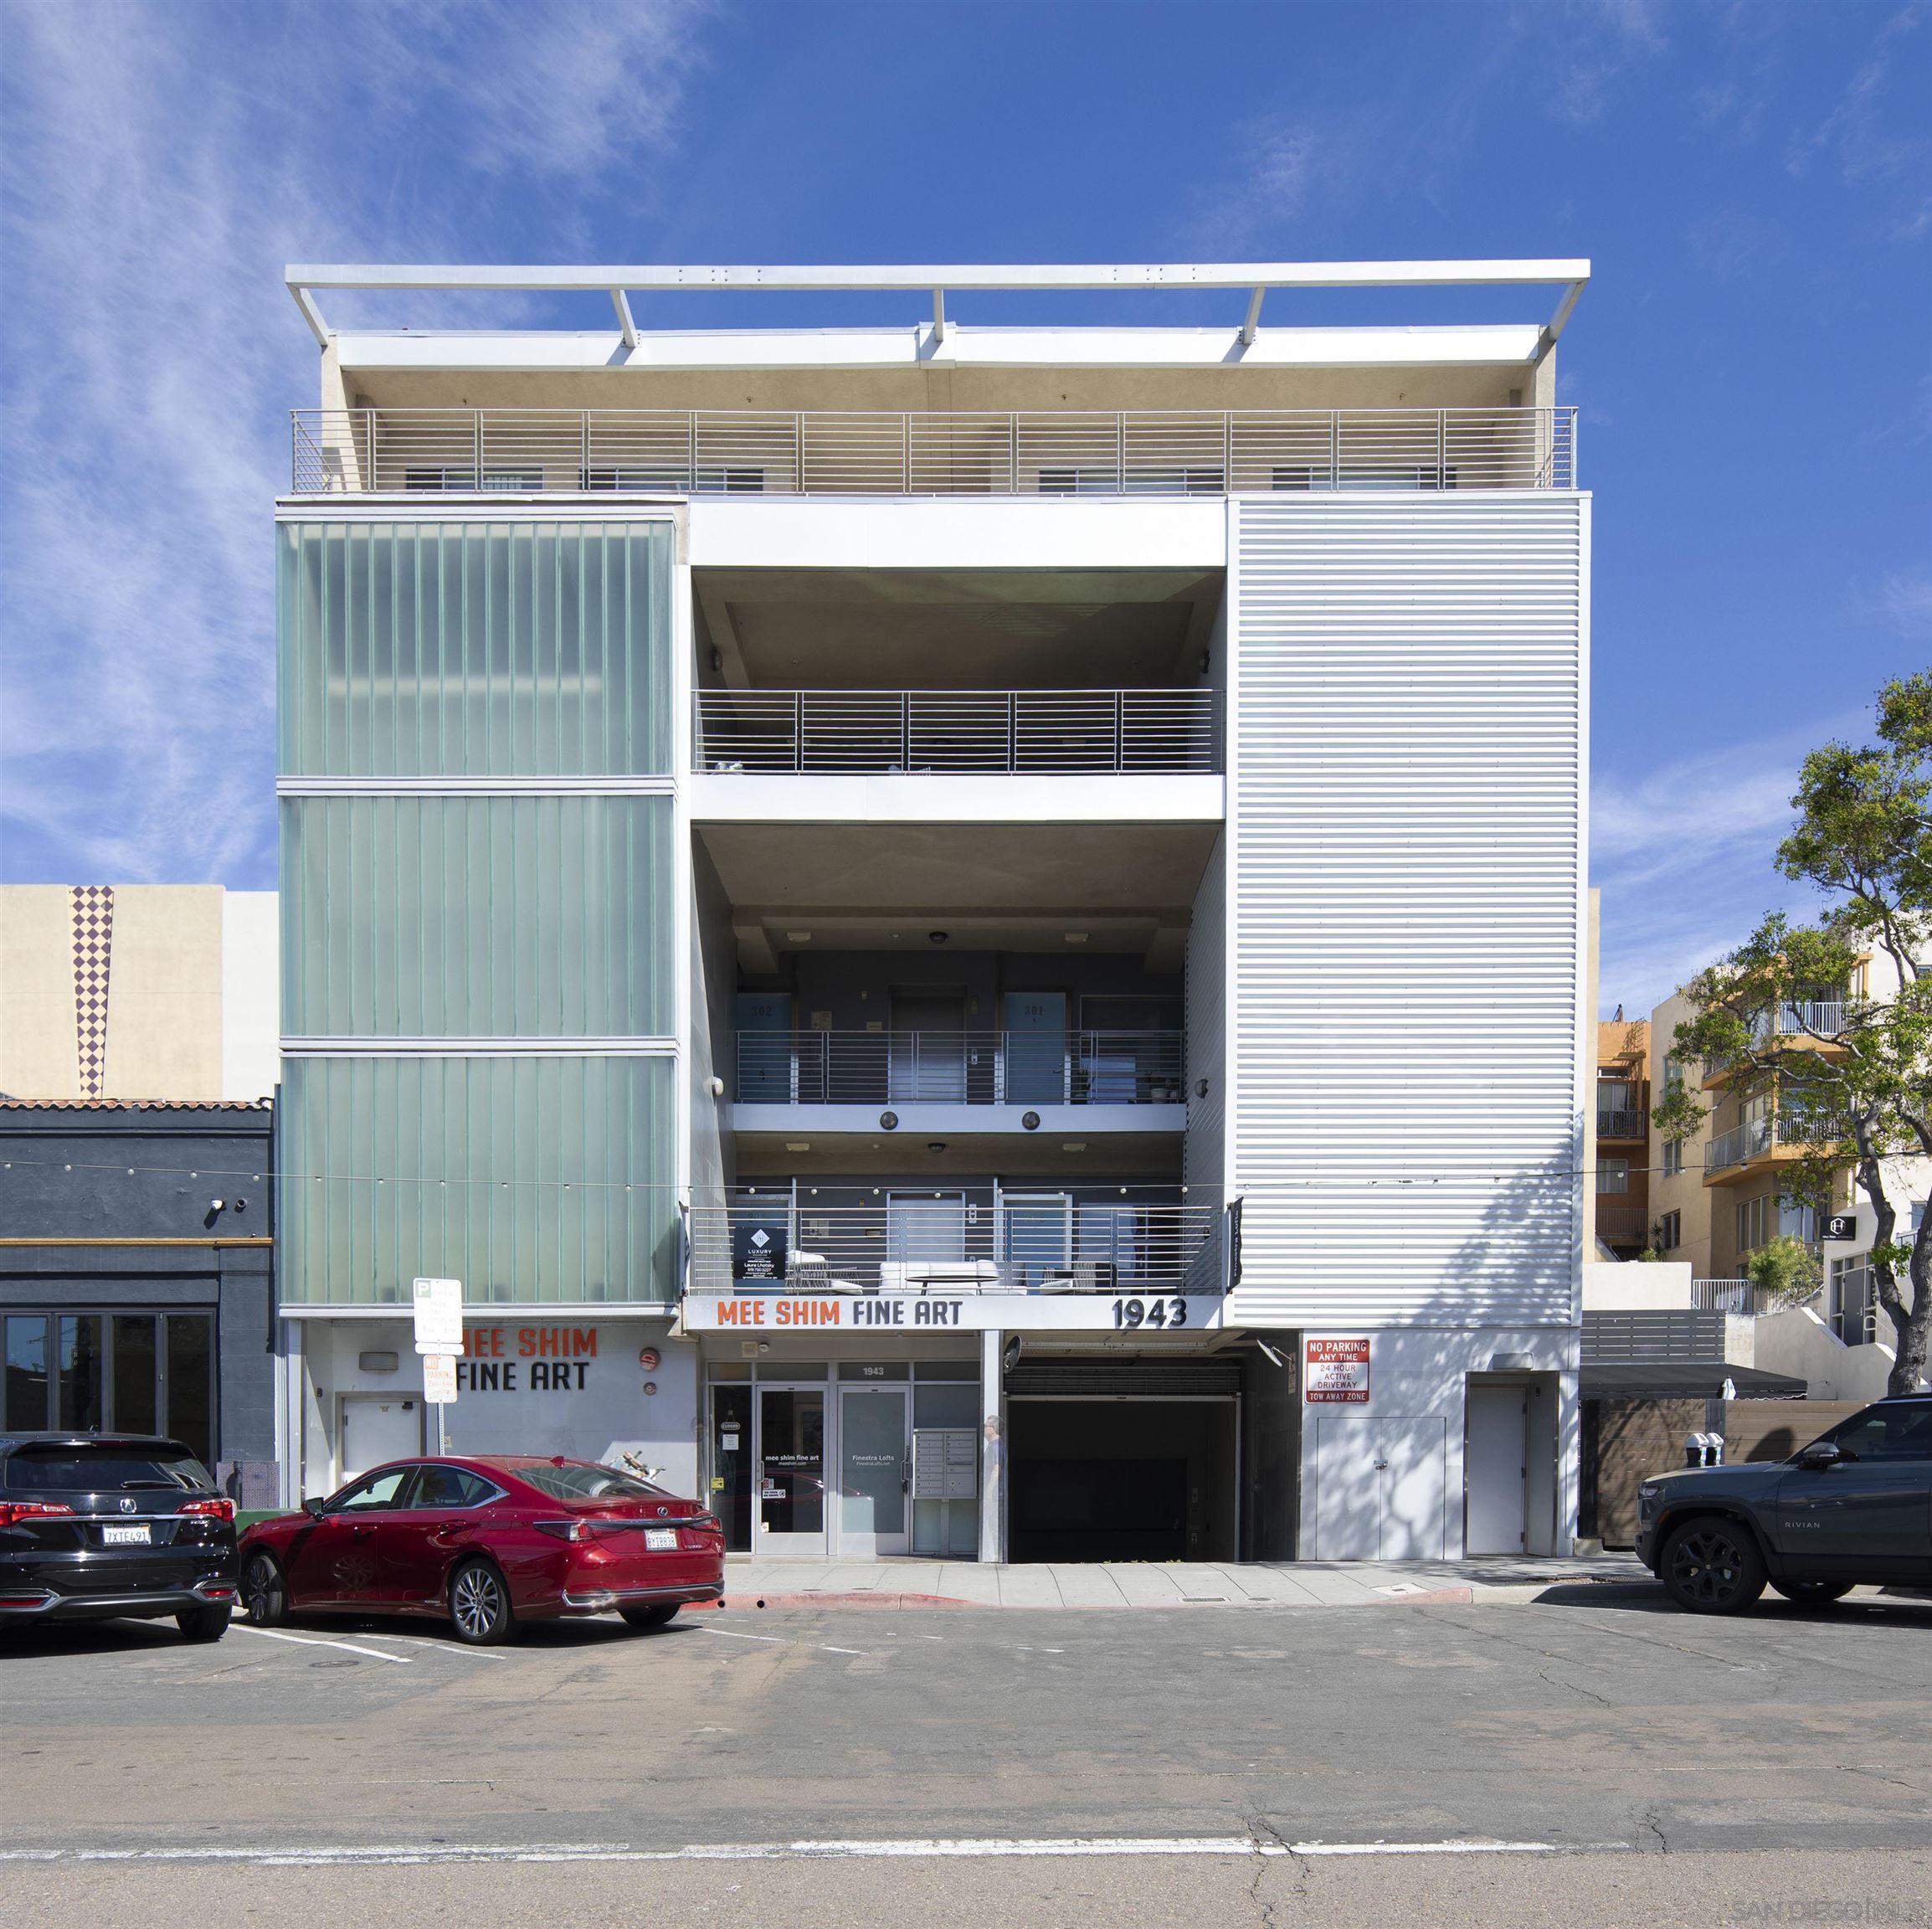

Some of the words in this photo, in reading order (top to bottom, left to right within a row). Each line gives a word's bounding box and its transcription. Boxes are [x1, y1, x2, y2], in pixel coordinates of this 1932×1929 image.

[418, 1282, 429, 1296] P
[717, 1301, 765, 1325] MEE
[776, 1301, 840, 1325] SHIM
[853, 1301, 904, 1325] FINE
[915, 1301, 963, 1325] ART
[1112, 1299, 1187, 1326] 1943
[518, 1328, 597, 1357] SHIM
[1310, 1342, 1323, 1352] NO
[1326, 1342, 1367, 1352] PARKING
[1318, 1353, 1337, 1361] ANY
[1339, 1353, 1358, 1361] TIME
[457, 1362, 516, 1391] FINE
[531, 1361, 589, 1391] ART
[1310, 1392, 1324, 1401] TOW
[1326, 1392, 1346, 1401] AWAY
[1347, 1392, 1366, 1401] ZONE
